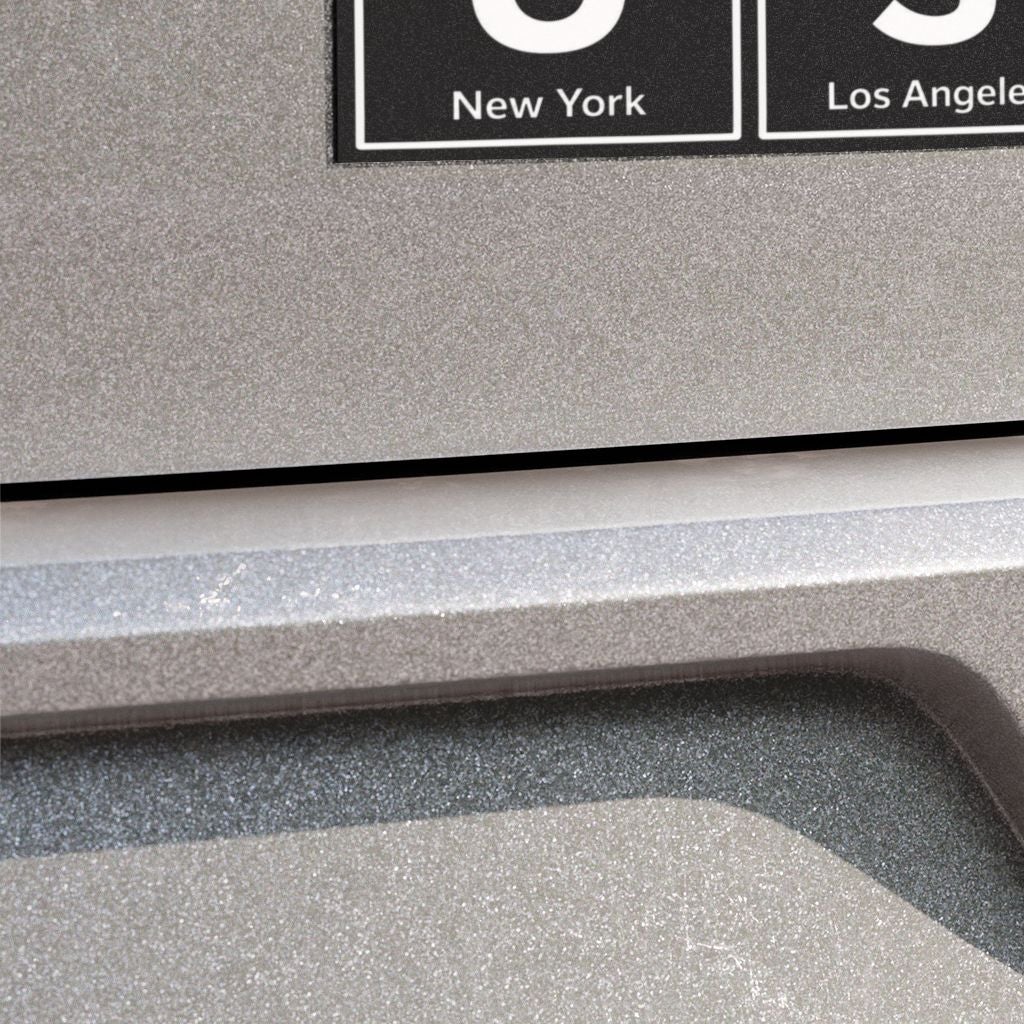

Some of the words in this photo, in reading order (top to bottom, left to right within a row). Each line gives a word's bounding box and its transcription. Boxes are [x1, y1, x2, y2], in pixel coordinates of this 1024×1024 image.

[452, 90, 544, 121] New
[557, 85, 647, 118] York
[828, 81, 891, 111] Los
